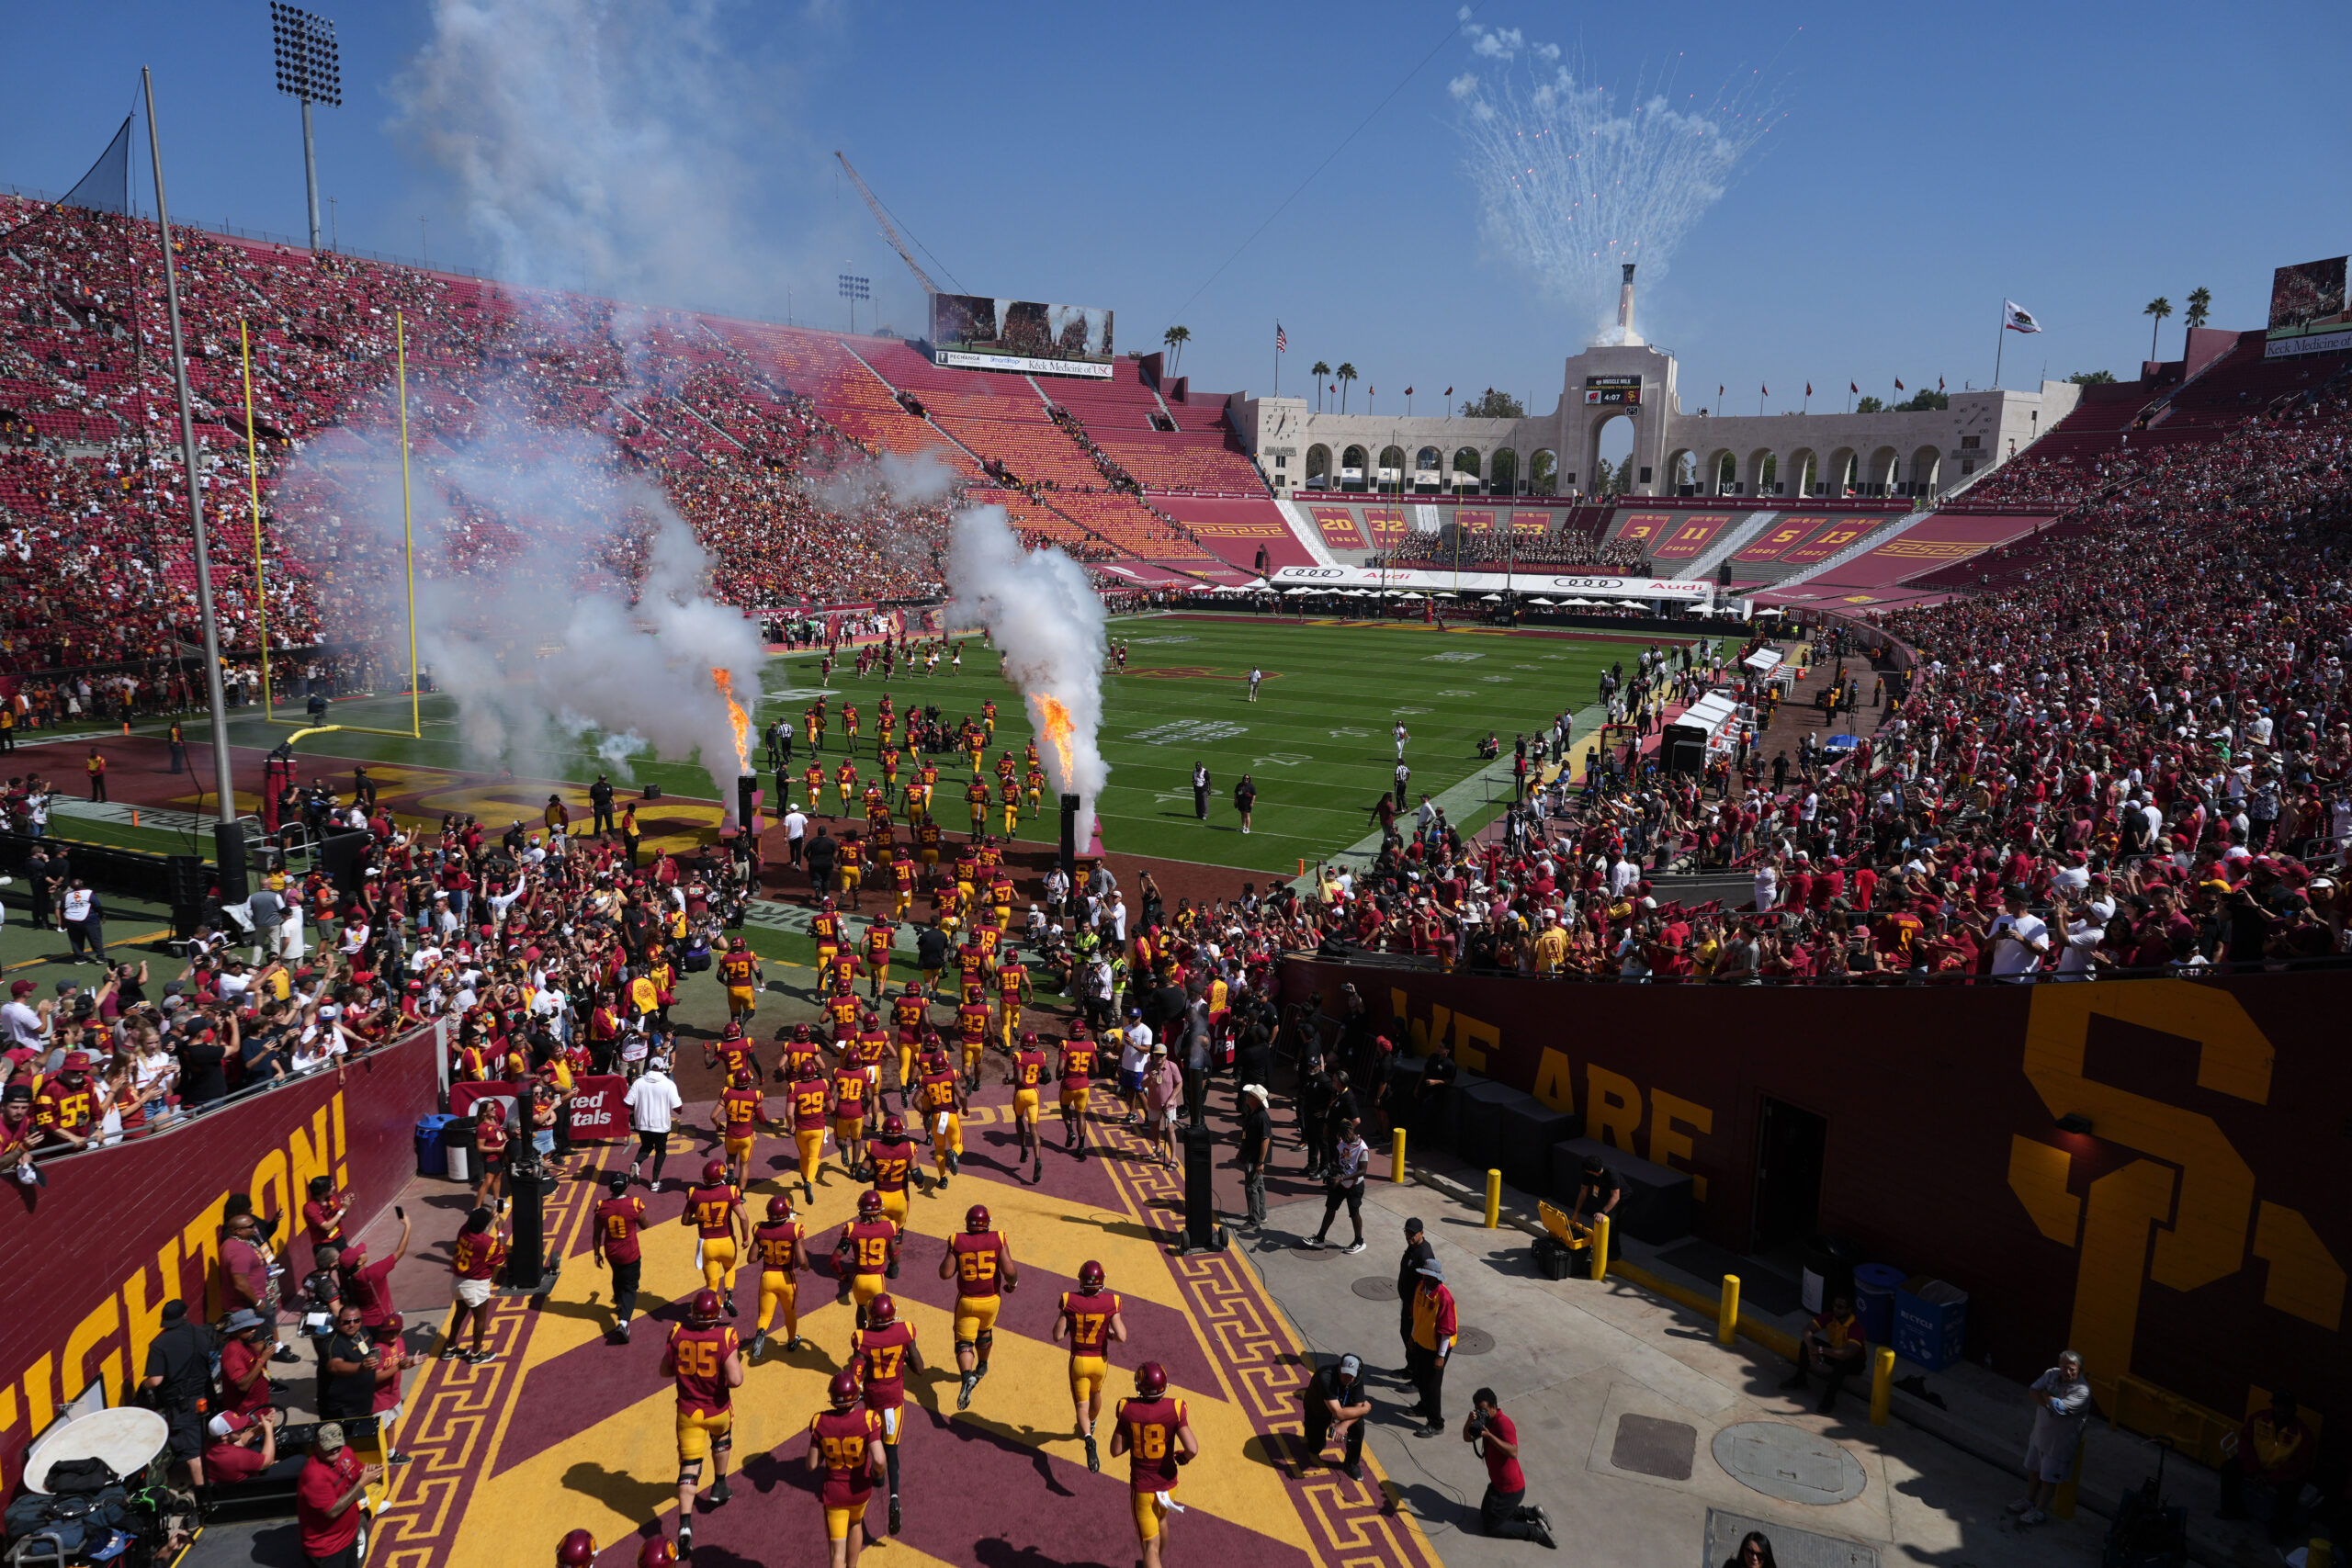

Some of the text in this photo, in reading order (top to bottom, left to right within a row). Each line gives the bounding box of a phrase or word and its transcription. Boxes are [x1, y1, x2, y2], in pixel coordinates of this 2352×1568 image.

[2267, 336, 2352, 355] Keck Medicine of
[989, 356, 1020, 366] SmartStop
[1029, 359, 1111, 375] Keck Medicine of USC
[1319, 518, 1353, 531] 20
[1371, 520, 1406, 531] 32
[1630, 526, 1652, 538] 3
[1679, 527, 1709, 540] 11
[1771, 529, 1801, 542] 5
[1816, 531, 1858, 544] 13
[1648, 582, 1702, 592] Audi
[888, 613, 900, 636] J
[845, 713, 854, 721] 15
[884, 718, 890, 728] 2
[1125, 719, 1201, 739] UNITED
[1147, 720, 1236, 746] AIRLINES
[1192, 727, 1250, 743] FIELD
[972, 737, 983, 746] 97
[1251, 752, 1314, 767] 20
[842, 770, 849, 781] 7
[921, 829, 937, 843] 56
[895, 865, 910, 880] 31
[939, 895, 956, 910] 34
[994, 886, 1011, 902] 57
[816, 919, 832, 935] 91
[872, 932, 888, 949] 51
[726, 961, 750, 979] 79
[840, 963, 851, 980] 9
[832, 1004, 855, 1024] 36
[899, 1007, 921, 1025] 23
[860, 1041, 885, 1060] 27
[728, 1051, 743, 1069] 2
[1068, 1051, 1092, 1073] 35
[1025, 1064, 1039, 1084] 8
[837, 1077, 863, 1100] 30
[926, 1080, 954, 1106] 86
[1391, 987, 1713, 1203] WE ARE
[59, 1093, 90, 1129] 55
[725, 1100, 754, 1122] 45
[797, 1091, 825, 1115] 29
[37, 1111, 53, 1126] 55
[248, 1089, 349, 1256] ON!
[876, 1159, 909, 1182] 72
[696, 1201, 729, 1228] 47
[608, 1215, 628, 1239] 0
[858, 1237, 887, 1266] 19
[958, 1250, 997, 1281] 65
[1075, 1313, 1106, 1345] 17
[1900, 1309, 1934, 1331] RECYCLE
[677, 1339, 718, 1378] 95
[871, 1345, 903, 1379] 17
[1130, 1422, 1167, 1459] 18
